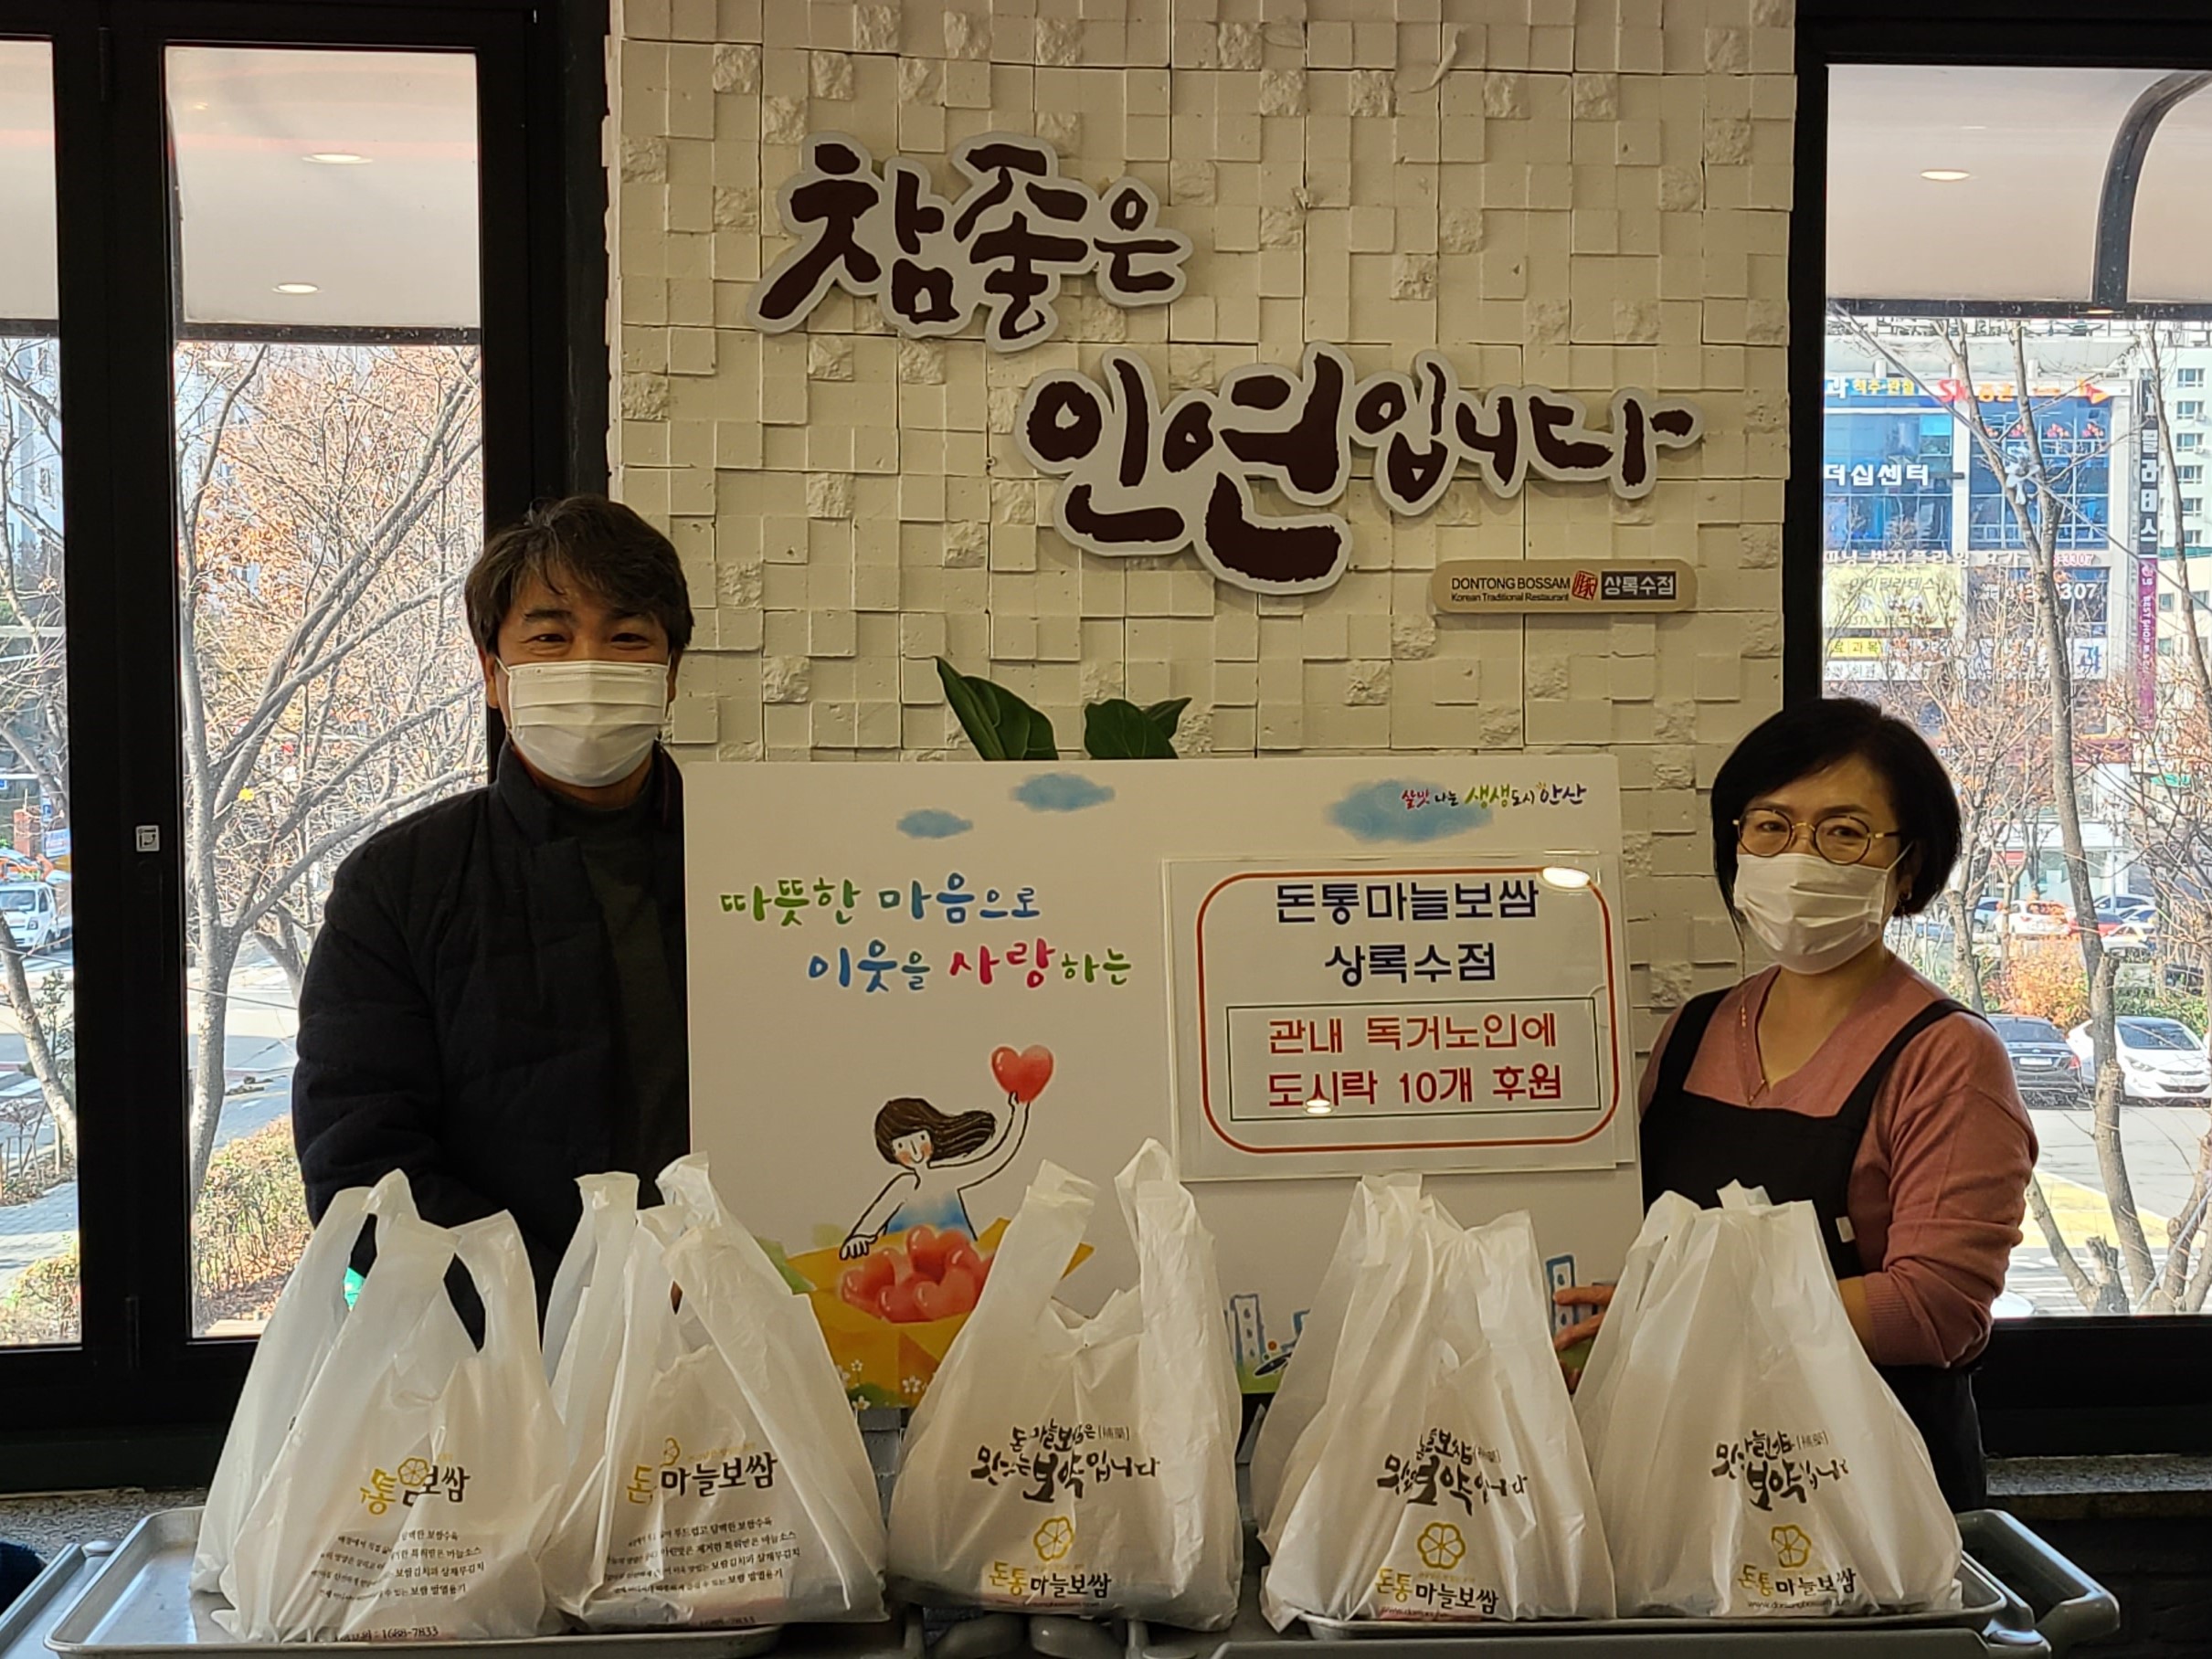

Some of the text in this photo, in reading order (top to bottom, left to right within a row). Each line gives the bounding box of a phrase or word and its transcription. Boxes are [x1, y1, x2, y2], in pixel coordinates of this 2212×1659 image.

[1026, 352, 1692, 580] 인연입니다
[1451, 576, 1571, 590] DONTONG BOSSAM
[1451, 592, 1570, 602] Korean Traditional Restaurant
[1603, 576, 1674, 596] 상록수점
[1434, 790, 1460, 807] 나는
[1540, 783, 1587, 806] 안산
[720, 872, 1041, 926] 따뜻한 마음으로
[1275, 879, 1540, 925] 돈통마늘보쌈
[808, 937, 1132, 993] 이웃을 사랑하는
[1325, 942, 1498, 988] 상록수점
[1268, 1012, 1557, 1055] 관내 독거노인에
[1268, 1063, 1562, 1108] 도시락 10개 후원
[989, 1560, 1112, 1599] 돈통마늘보쌈
[1374, 1568, 1499, 1615] 돈통마늘보쌈
